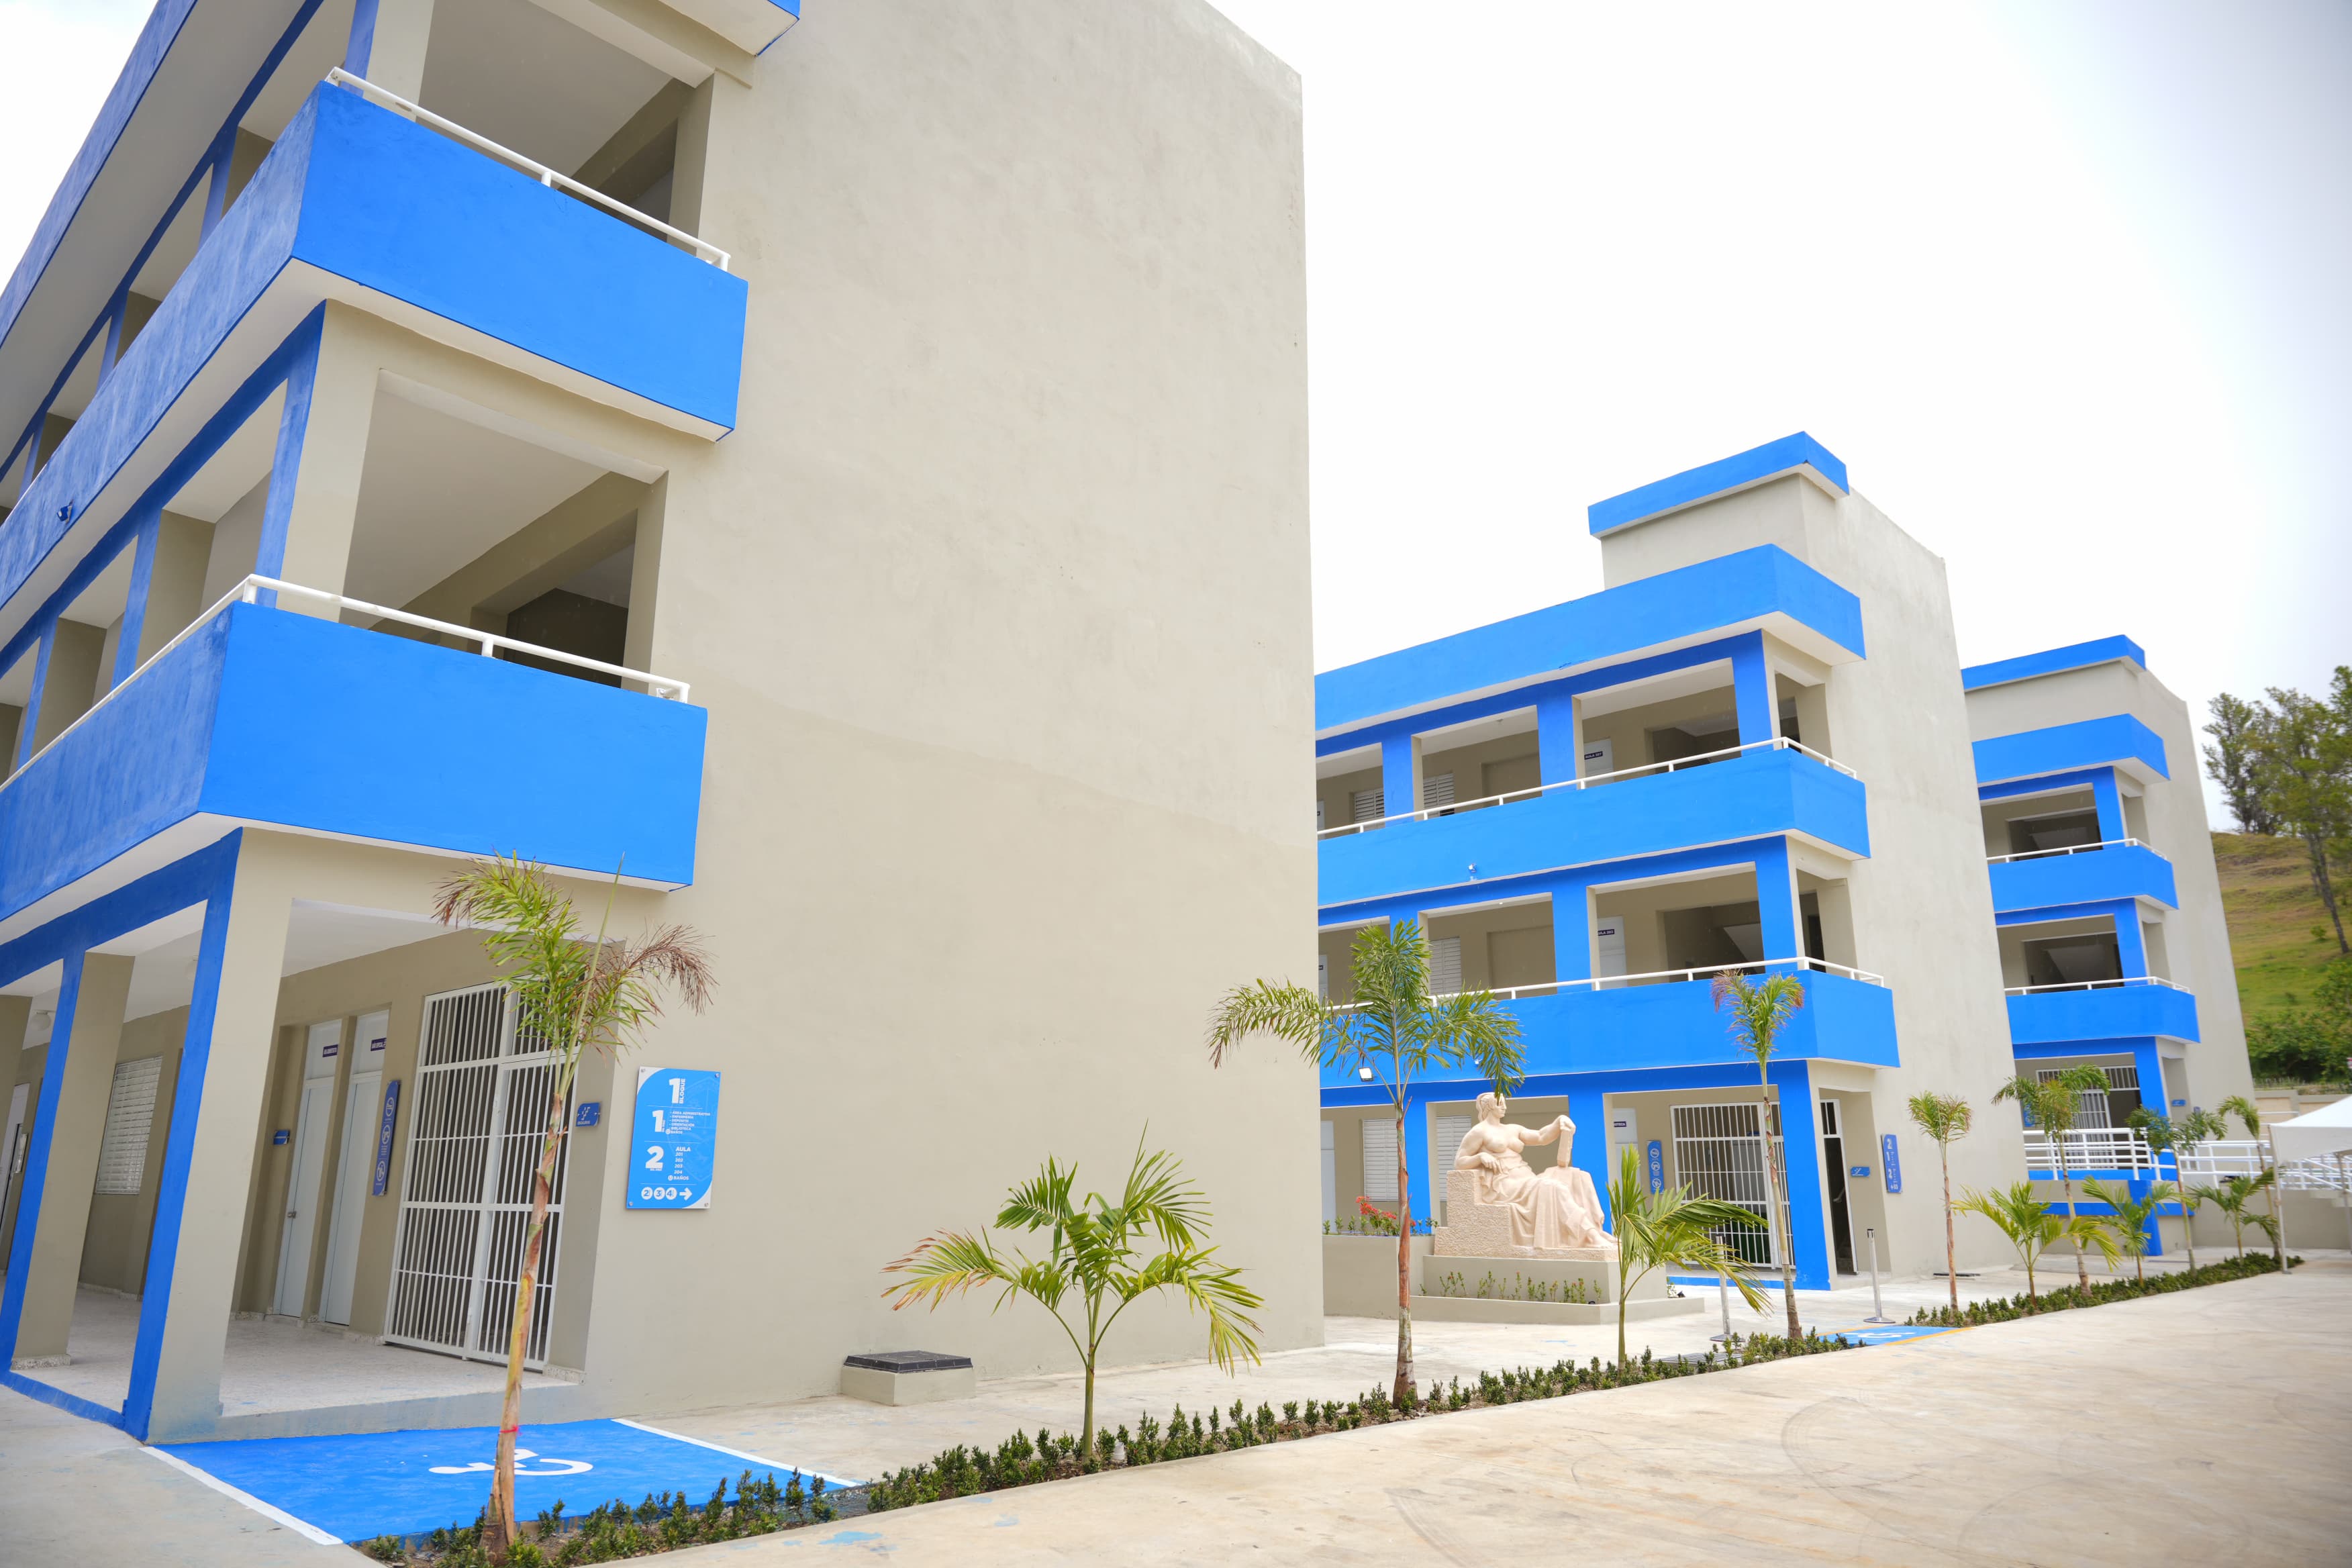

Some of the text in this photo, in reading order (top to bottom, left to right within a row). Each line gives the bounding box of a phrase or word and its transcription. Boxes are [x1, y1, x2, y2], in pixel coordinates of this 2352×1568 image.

[669, 1078, 680, 1104] 1
[652, 1110, 664, 1132] 1
[1887, 1138, 1892, 1150] 2
[646, 1146, 664, 1169] 2
